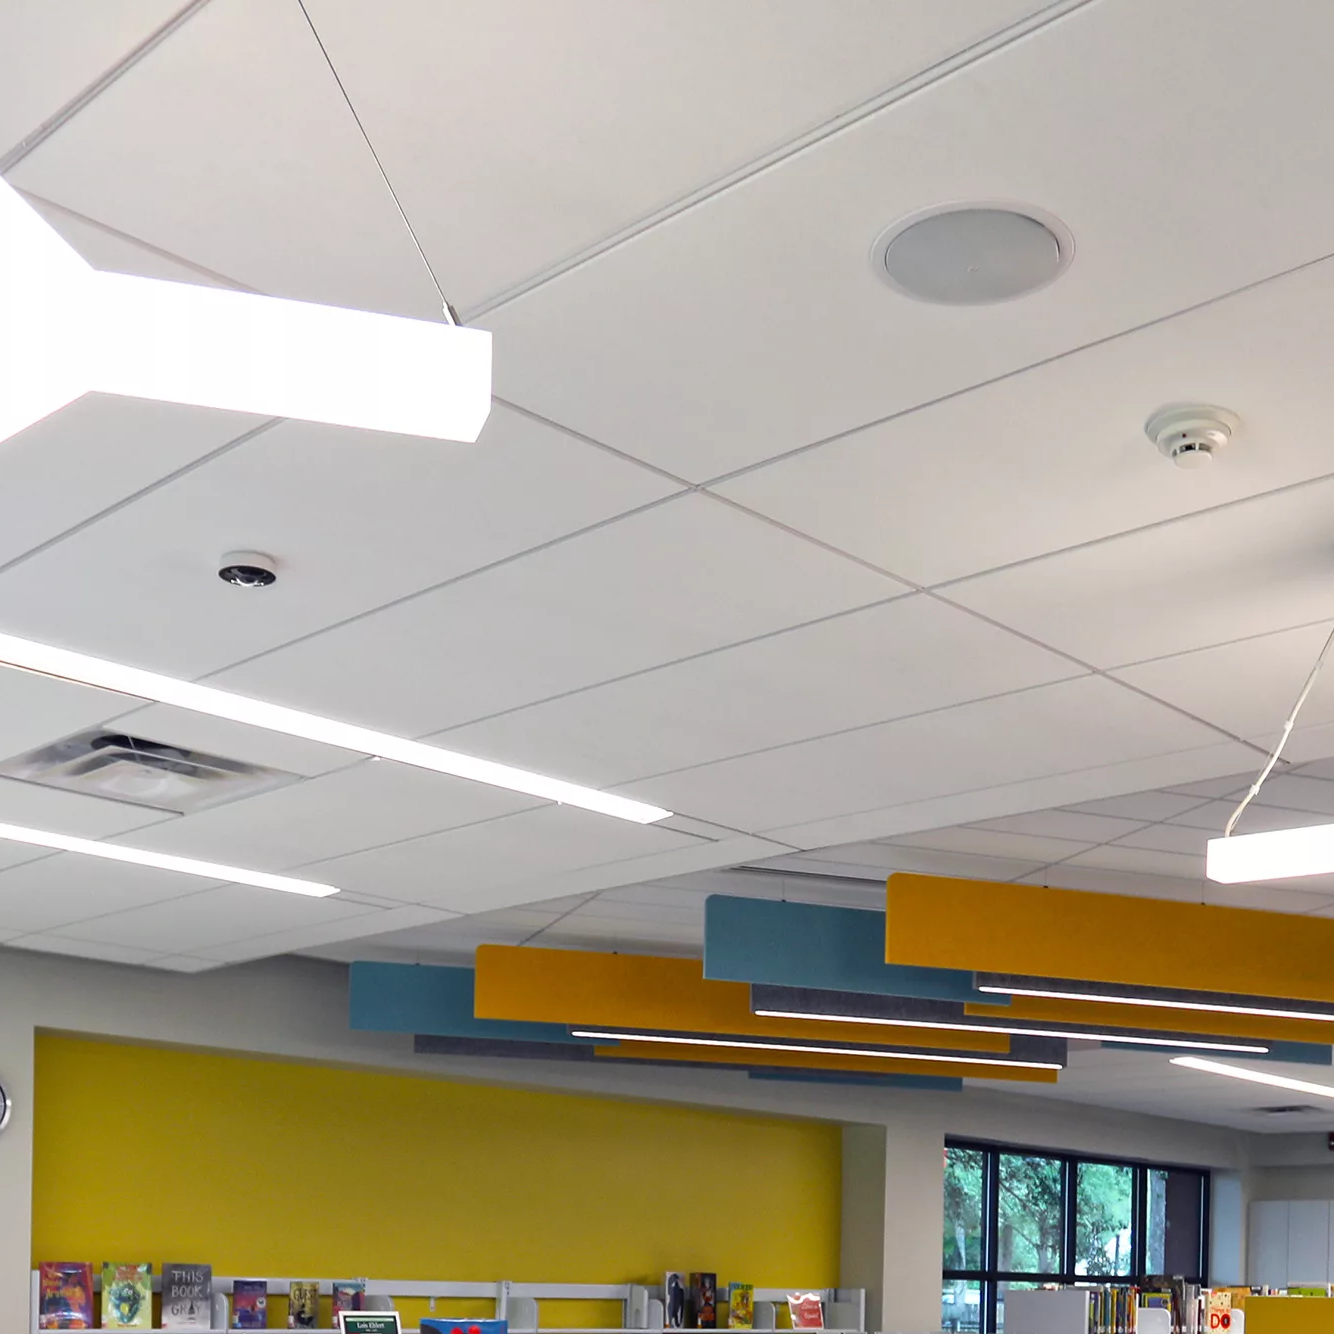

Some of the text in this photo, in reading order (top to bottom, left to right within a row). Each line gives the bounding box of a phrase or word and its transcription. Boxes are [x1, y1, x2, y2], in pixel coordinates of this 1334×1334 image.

[172, 1271, 204, 1282] THIS
[171, 1286, 202, 1298] BOOK
[1210, 1313, 1231, 1329] DO
